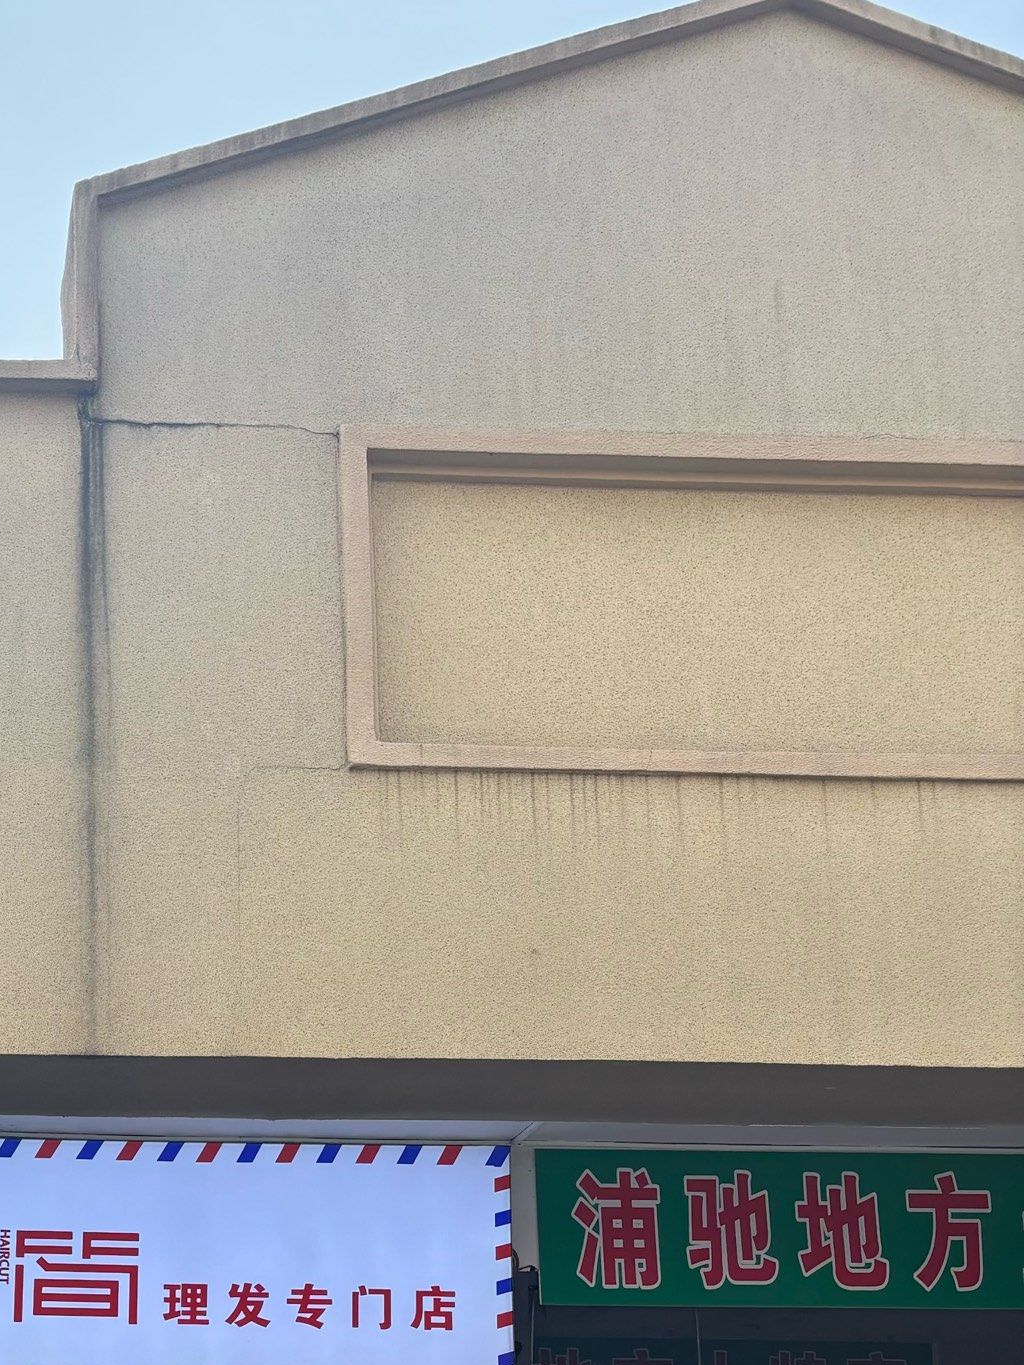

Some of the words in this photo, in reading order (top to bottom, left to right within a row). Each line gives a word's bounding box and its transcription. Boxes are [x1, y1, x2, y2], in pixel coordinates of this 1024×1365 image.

[571, 1167, 1024, 1291] 浦驰地方
[162, 1282, 457, 1331] 理发专门店
